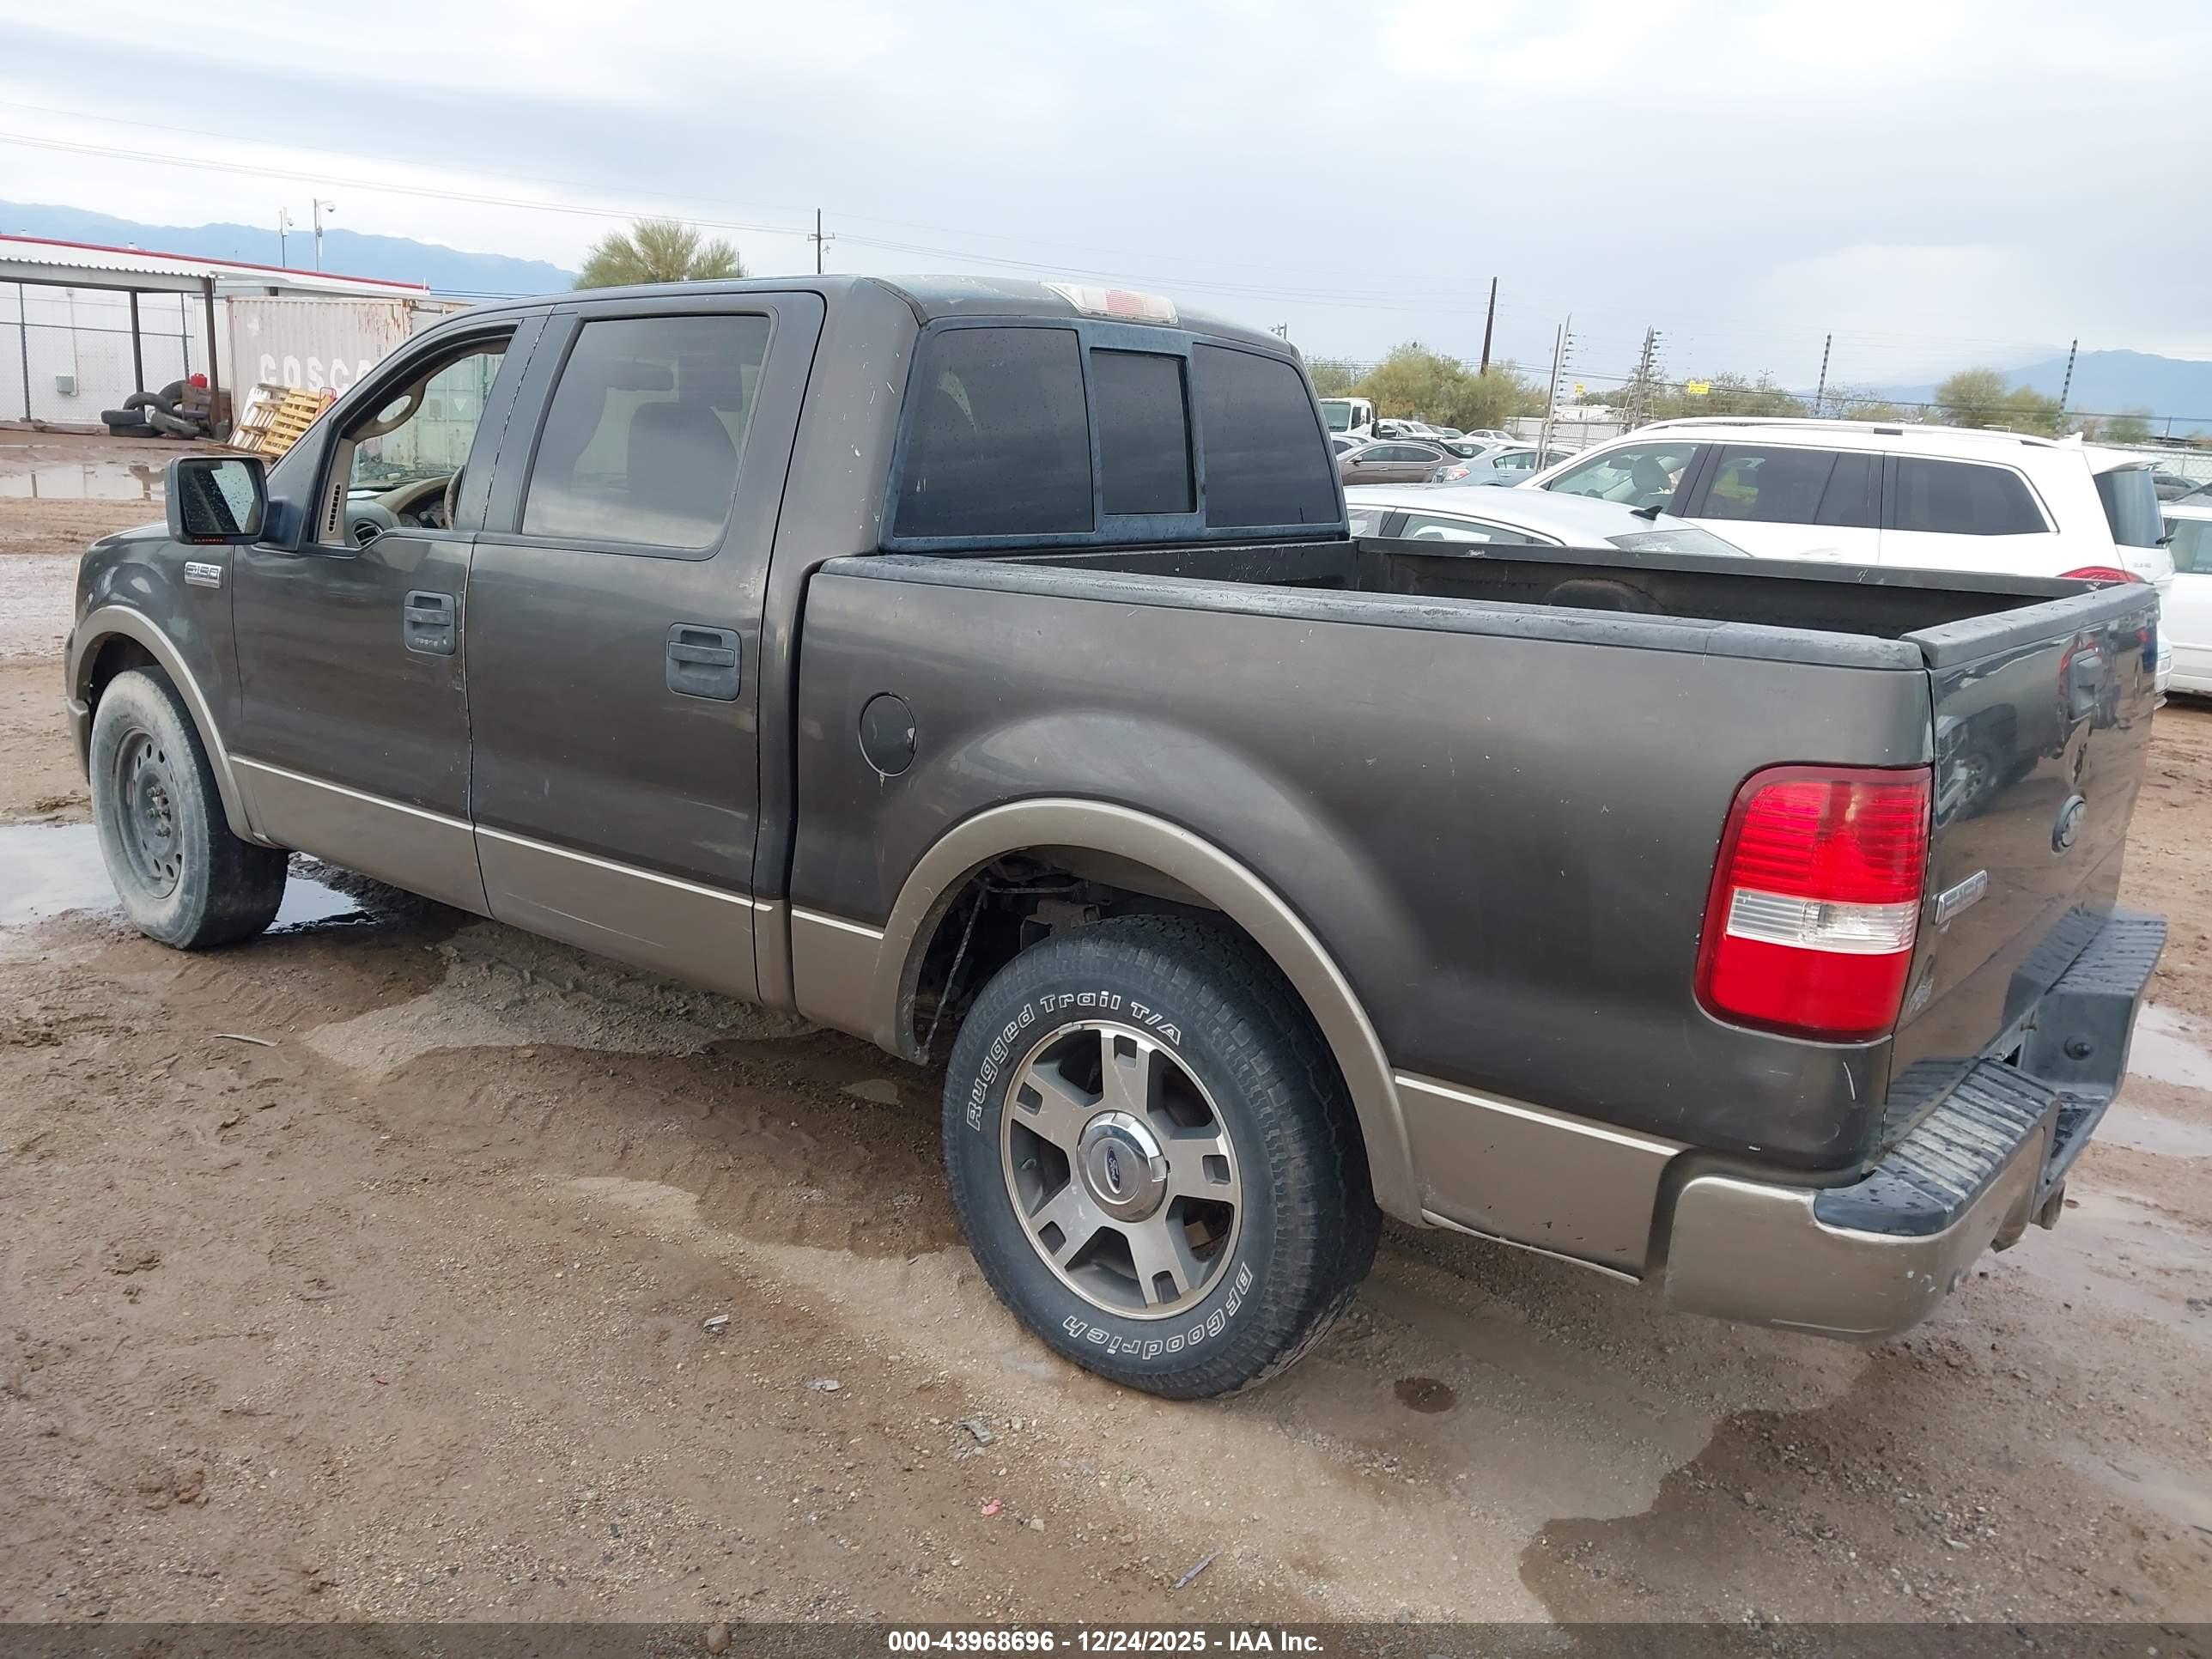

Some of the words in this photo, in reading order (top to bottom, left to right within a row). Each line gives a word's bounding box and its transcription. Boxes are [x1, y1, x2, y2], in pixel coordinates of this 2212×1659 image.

[967, 1003, 1036, 1132] Rugged
[1039, 990, 1121, 1013] Trail
[1129, 1000, 1182, 1046] T/A
